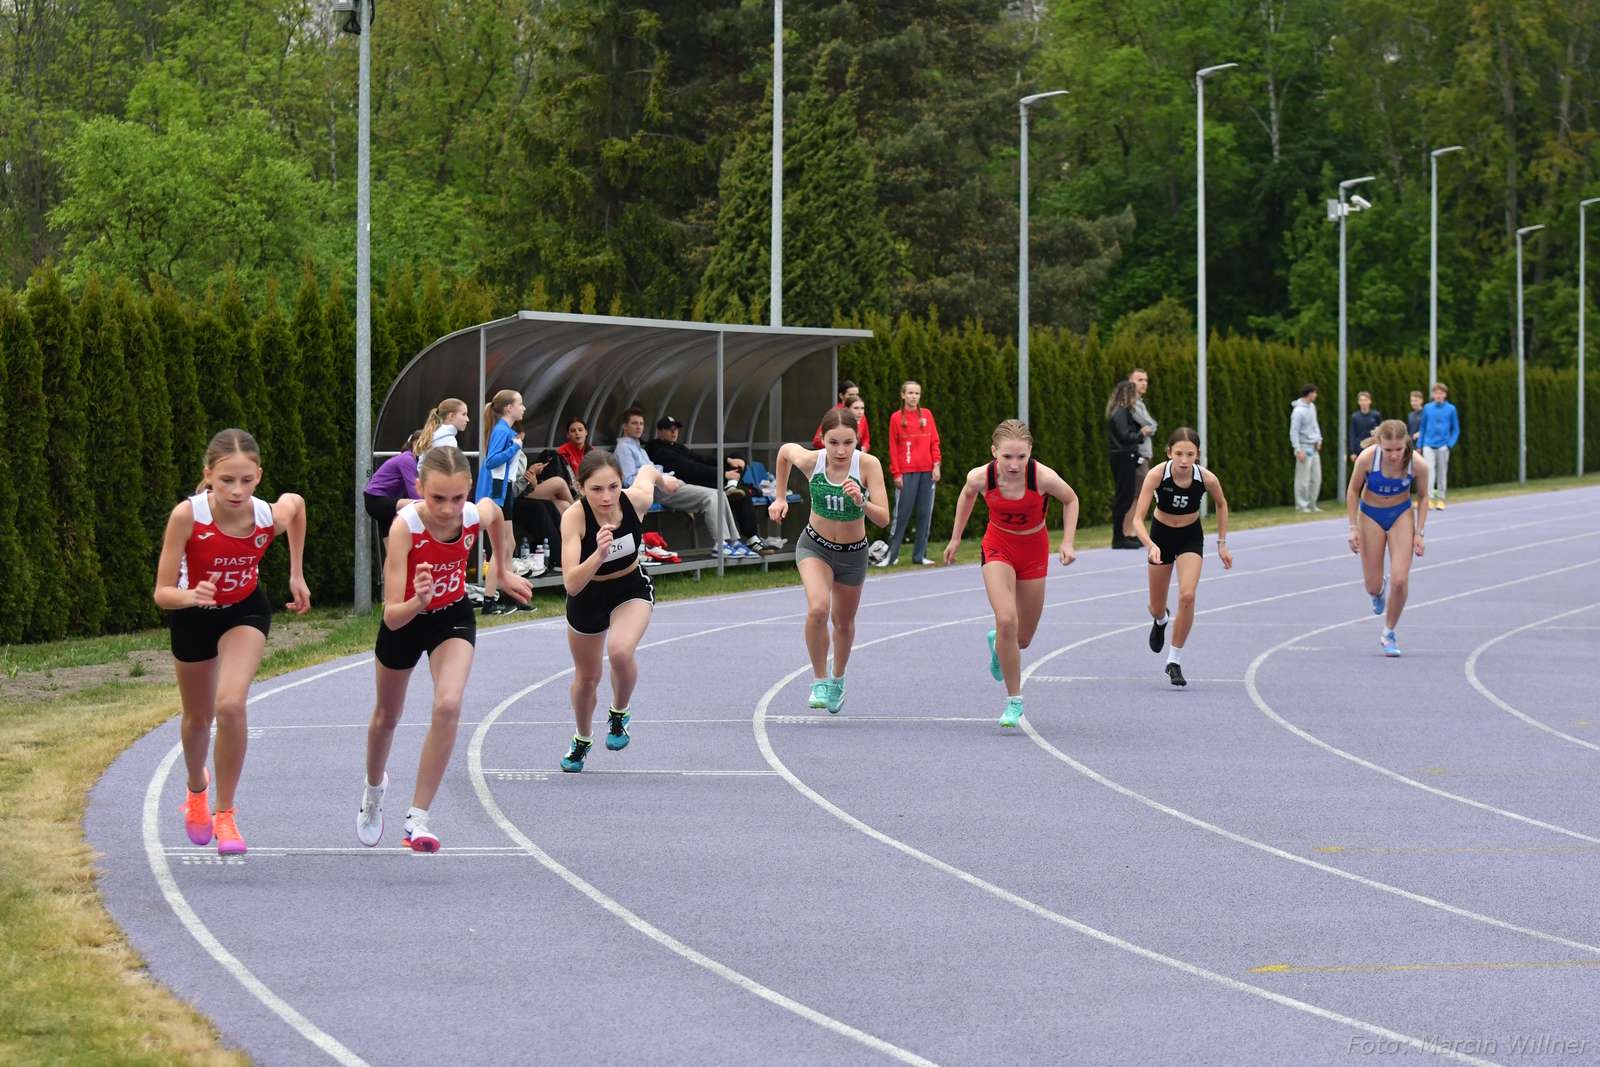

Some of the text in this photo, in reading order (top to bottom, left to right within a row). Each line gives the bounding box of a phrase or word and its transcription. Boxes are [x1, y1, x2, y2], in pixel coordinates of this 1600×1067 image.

[825, 494, 845, 512] 111
[1172, 495, 1189, 508] 55
[817, 537, 843, 551] PRO
[214, 555, 257, 567] PIAST
[431, 559, 465, 572] IAST
